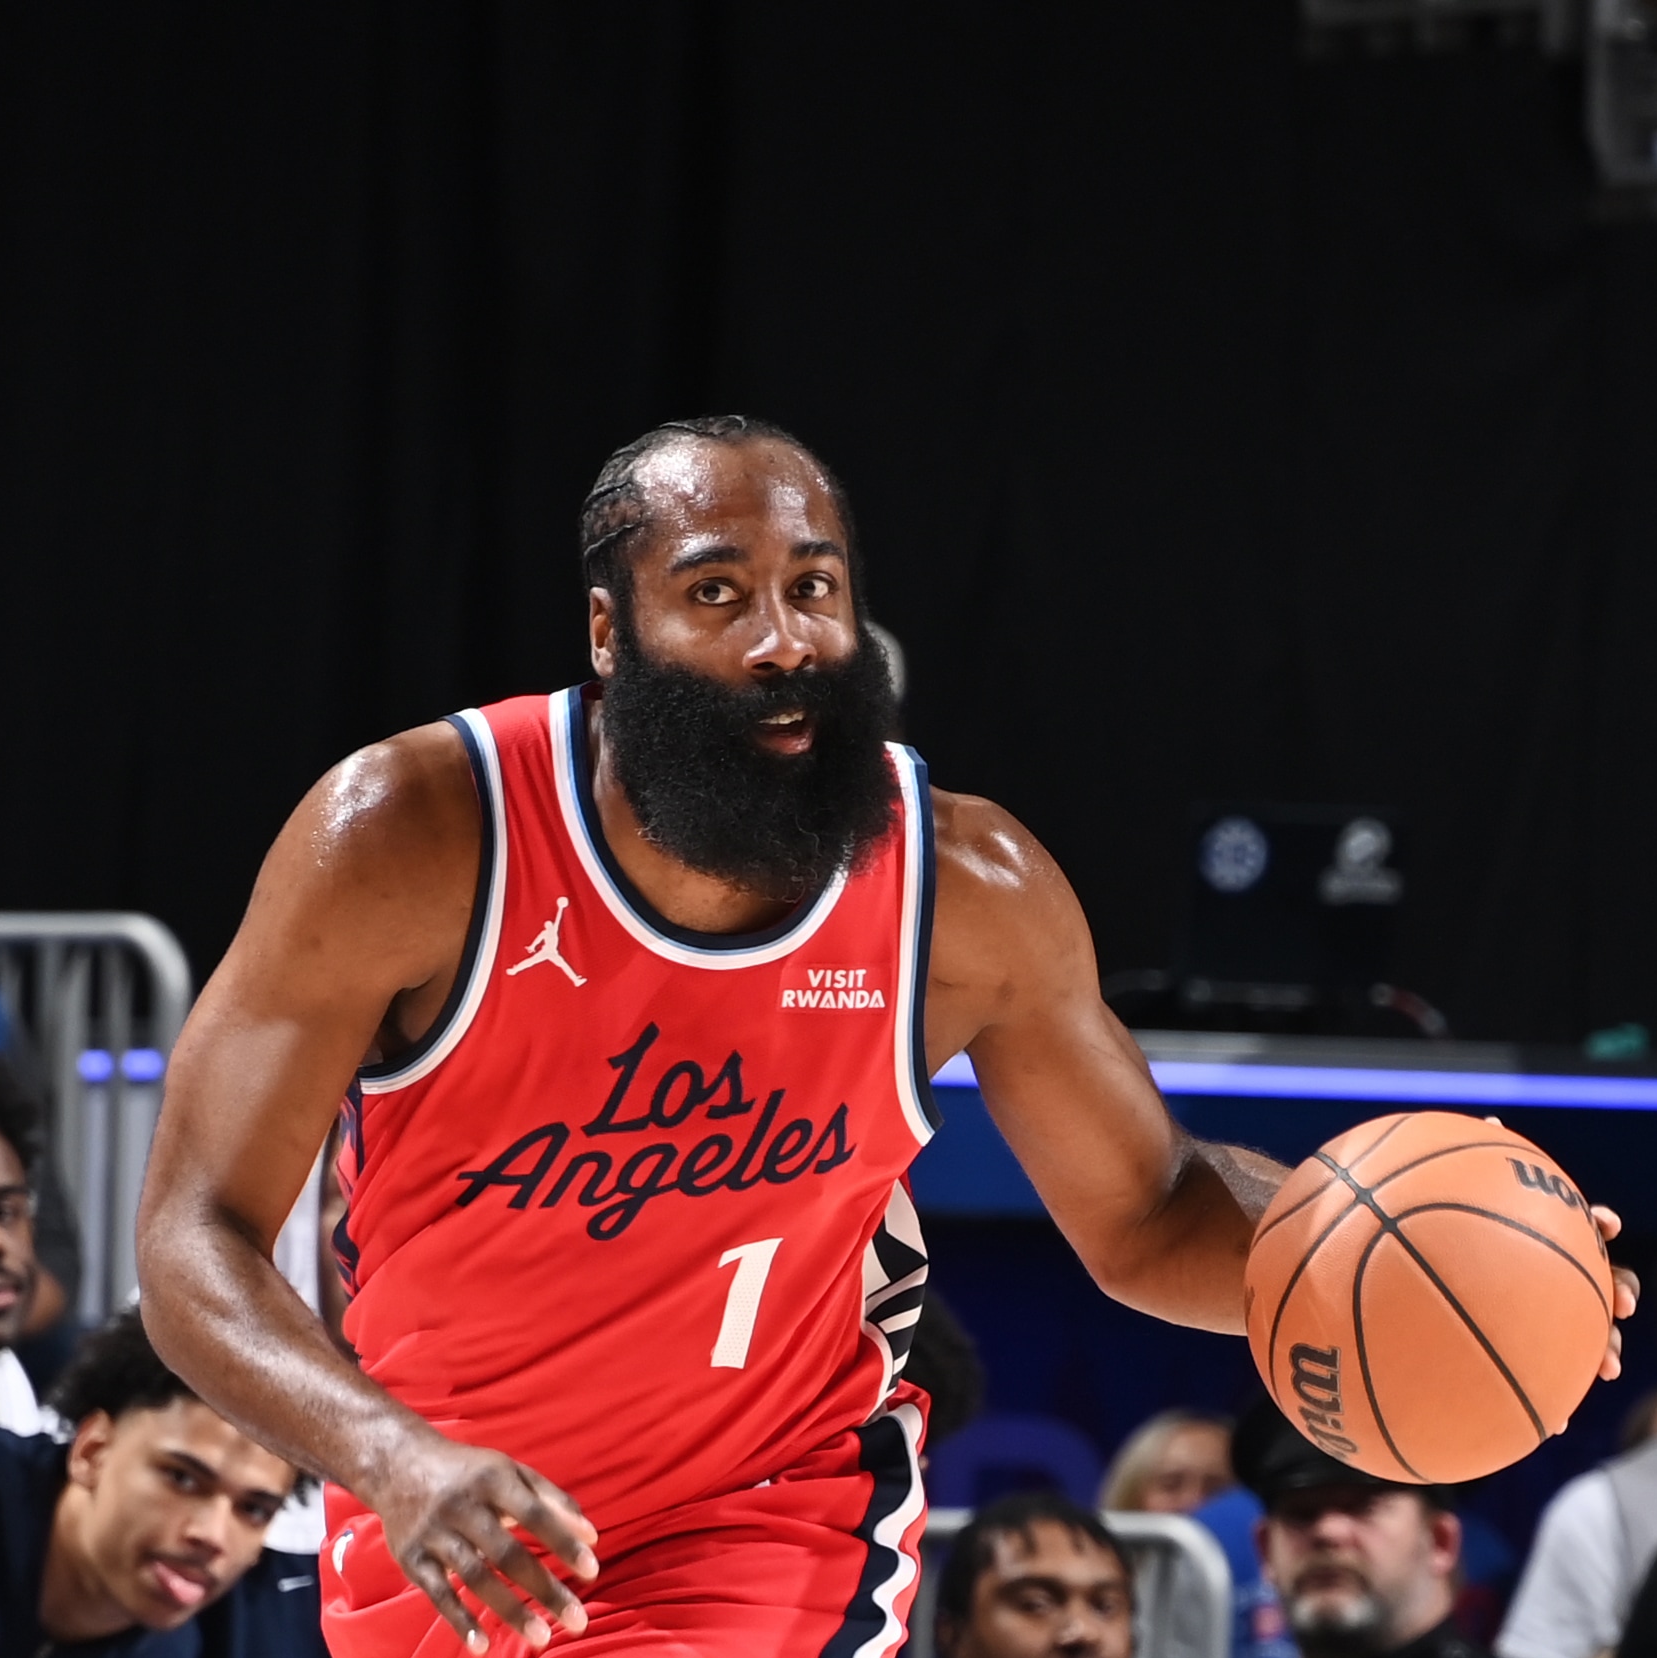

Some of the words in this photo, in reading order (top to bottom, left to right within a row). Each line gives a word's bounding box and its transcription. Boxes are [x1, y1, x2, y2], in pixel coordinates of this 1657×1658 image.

[781, 989, 885, 1009] RWANDA
[807, 968, 866, 989] VISIT
[581, 1022, 756, 1136] Los
[455, 1088, 857, 1241] Angeles
[710, 1237, 784, 1369] 1
